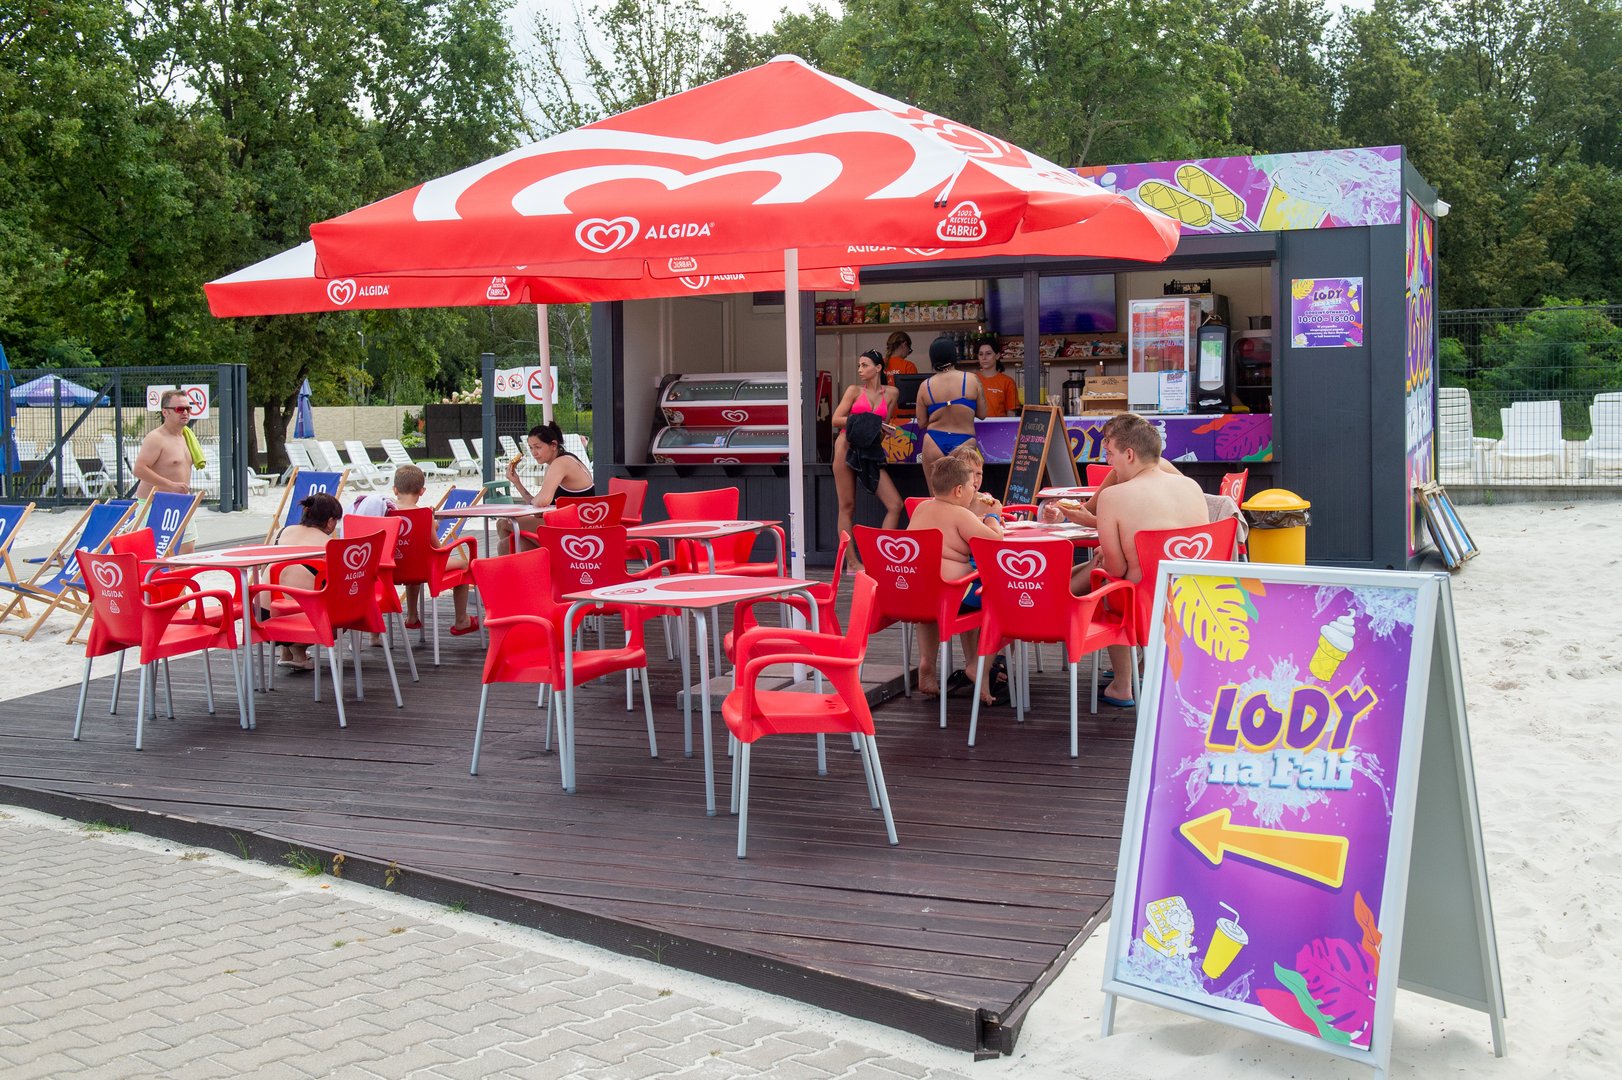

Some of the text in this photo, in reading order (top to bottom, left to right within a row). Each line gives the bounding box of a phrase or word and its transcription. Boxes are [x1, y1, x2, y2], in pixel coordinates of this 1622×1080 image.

[950, 216, 978, 225] RECYCLED
[1313, 288, 1344, 302] LODY
[1298, 315, 1323, 324] 10:00
[1330, 314, 1356, 323] 18:00
[886, 564, 916, 574] ALGIDA
[1007, 581, 1042, 590] ALGIDA
[1204, 684, 1379, 757] LODY
[1206, 751, 1354, 791] na Fali
